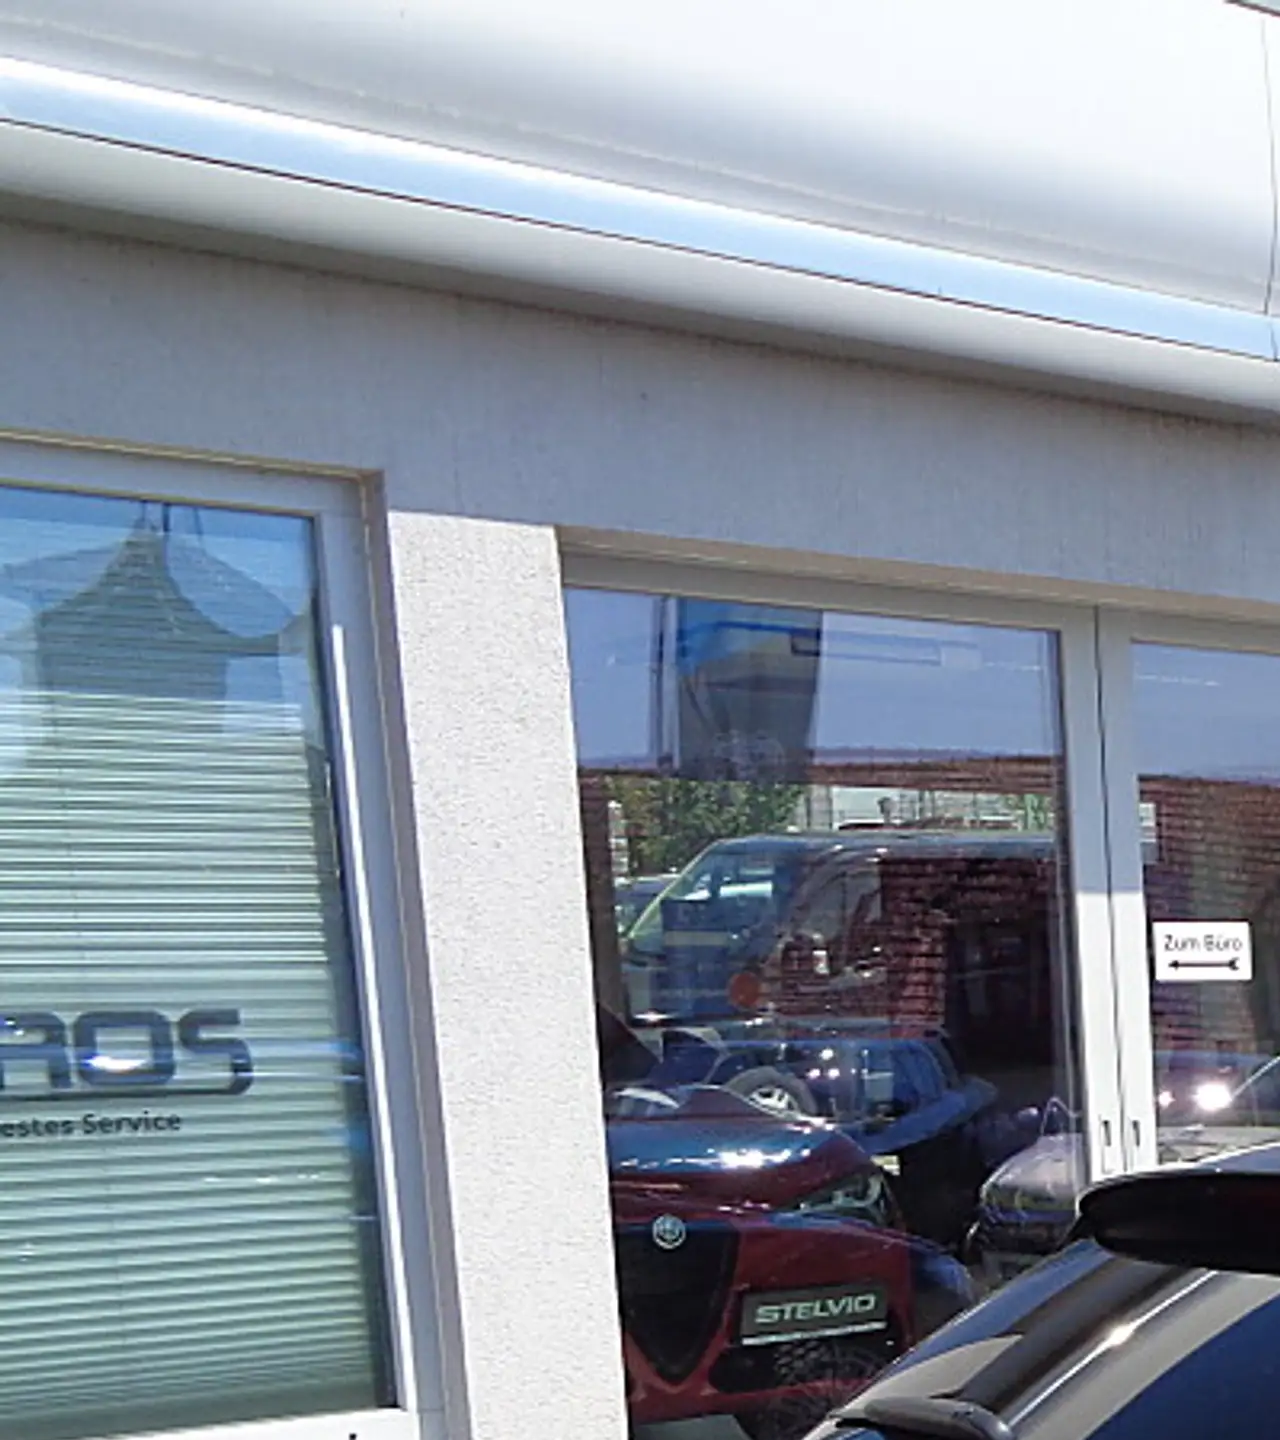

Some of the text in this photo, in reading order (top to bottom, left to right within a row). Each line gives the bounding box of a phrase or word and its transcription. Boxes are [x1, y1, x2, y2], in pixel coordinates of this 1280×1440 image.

[1164, 933, 1243, 952] Zum Büro
[82, 1111, 182, 1135] Service
[755, 1293, 877, 1324] STELVIO
